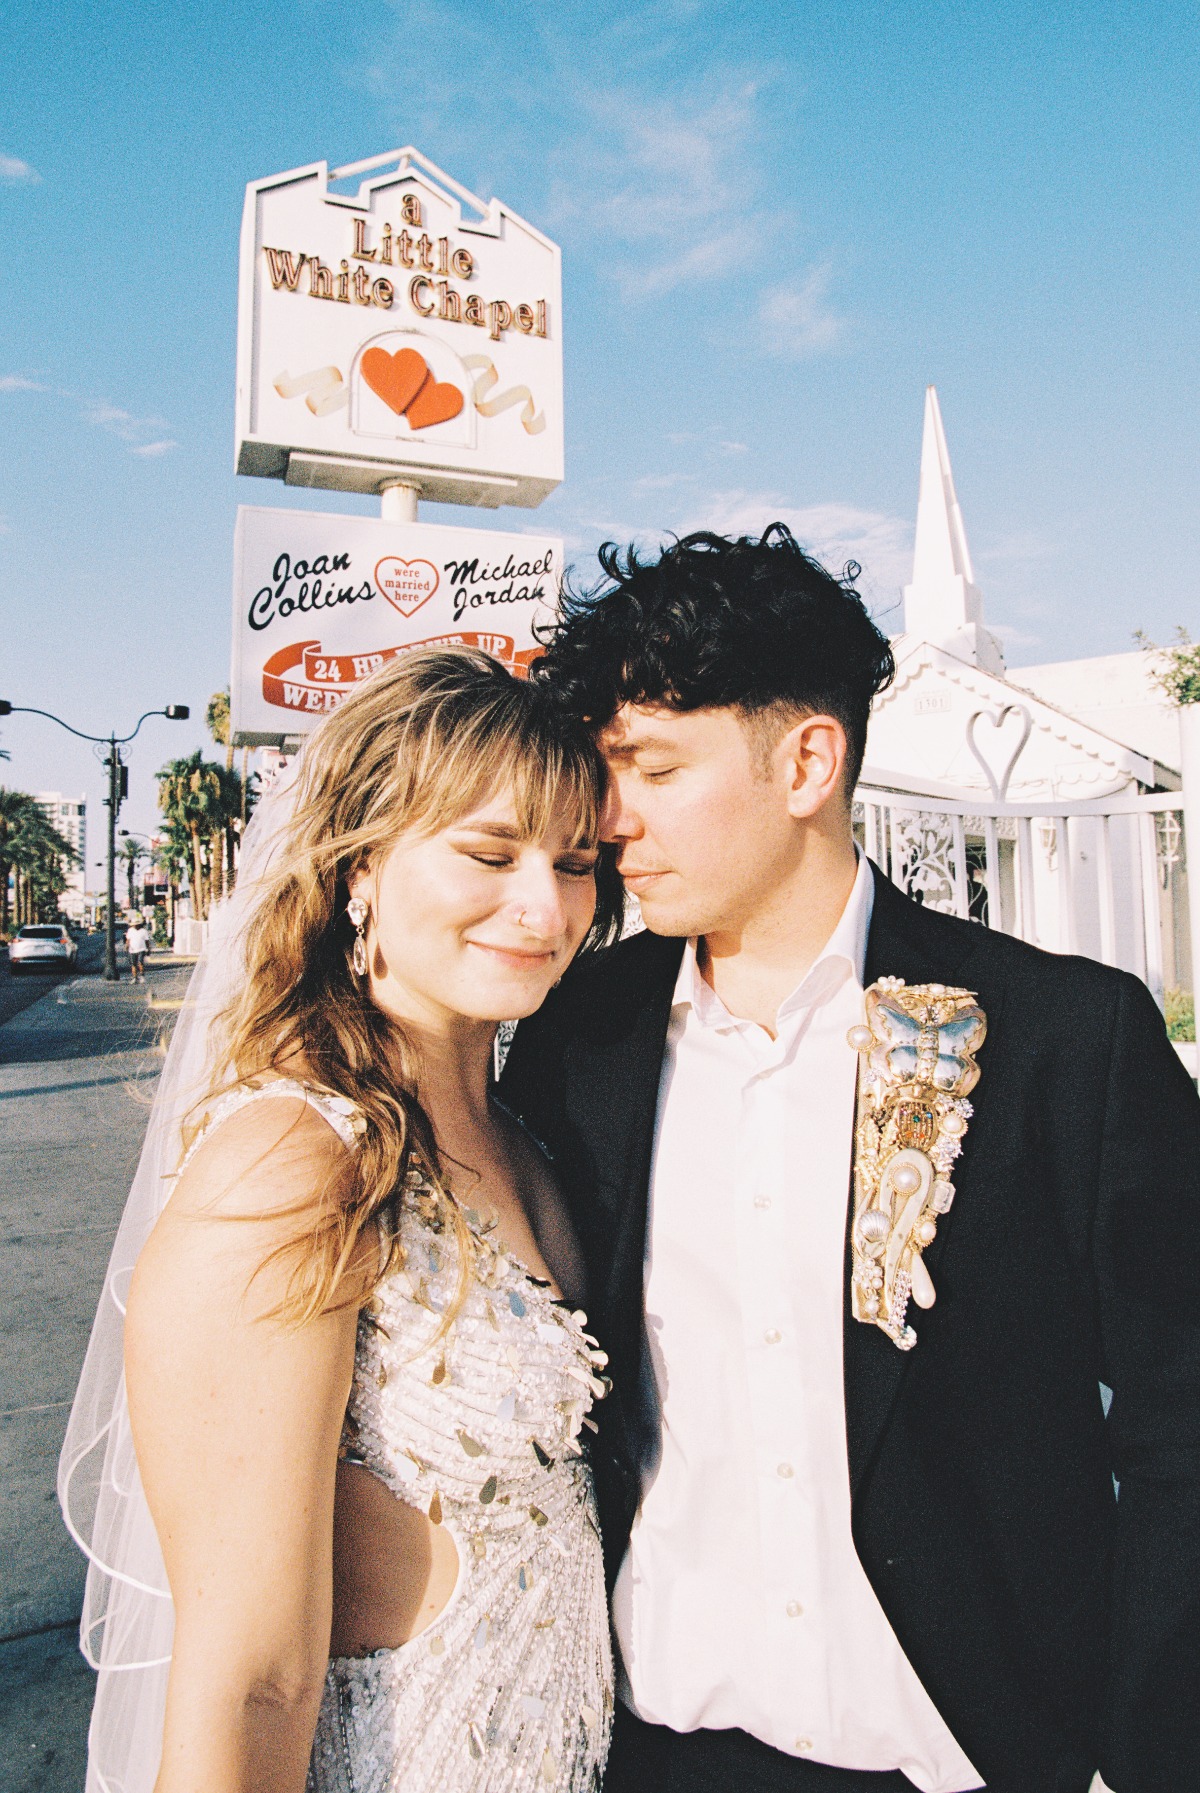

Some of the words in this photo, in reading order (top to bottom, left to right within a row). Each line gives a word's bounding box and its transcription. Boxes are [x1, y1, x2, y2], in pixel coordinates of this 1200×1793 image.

[401, 193, 423, 227] a
[351, 218, 474, 279] Little
[263, 246, 395, 310] White
[408, 275, 548, 341] Chapel
[273, 552, 351, 599] Joan
[385, 580, 430, 590] married
[394, 568, 420, 578] were
[444, 549, 553, 585] Michael
[248, 579, 377, 631] Collins
[394, 590, 419, 602] here
[453, 580, 546, 622] Jordan
[314, 659, 342, 682] 24
[477, 634, 506, 655] UP
[283, 683, 350, 712] WED
